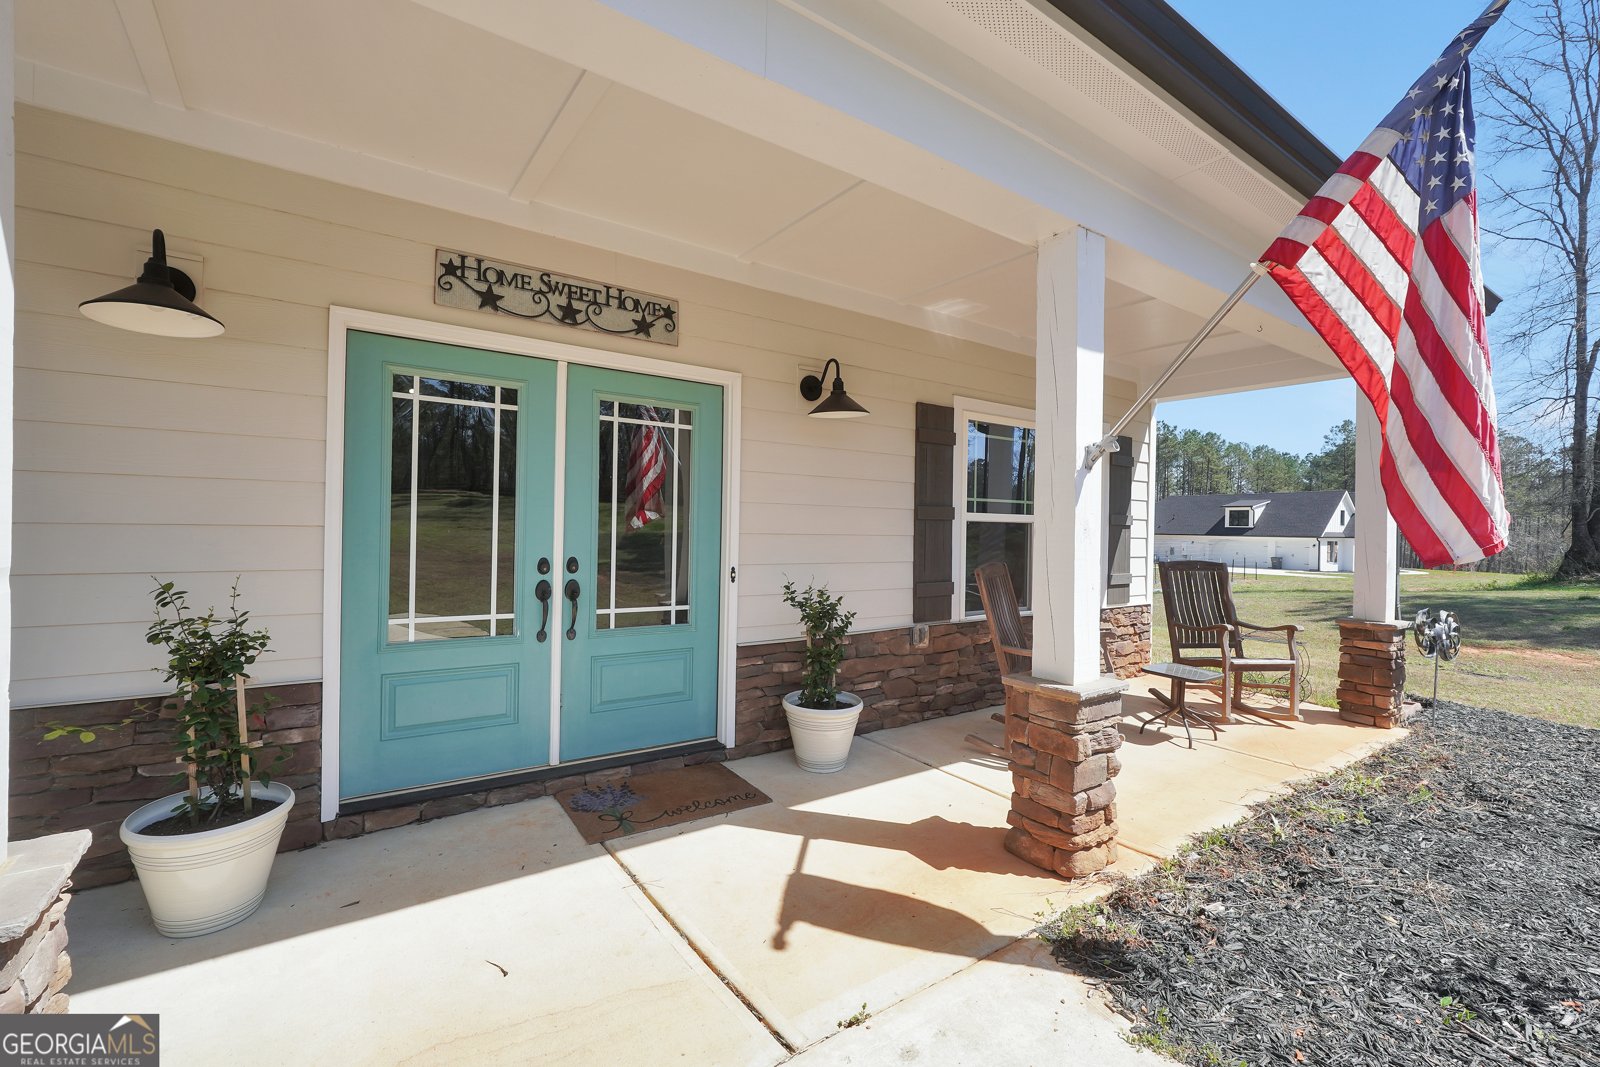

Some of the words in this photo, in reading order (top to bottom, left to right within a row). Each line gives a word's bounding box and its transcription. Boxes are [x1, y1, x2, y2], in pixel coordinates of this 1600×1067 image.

[458, 254, 533, 291] HOME
[539, 272, 603, 305] SWEET
[602, 285, 662, 317] HOME
[663, 792, 757, 818] welcome
